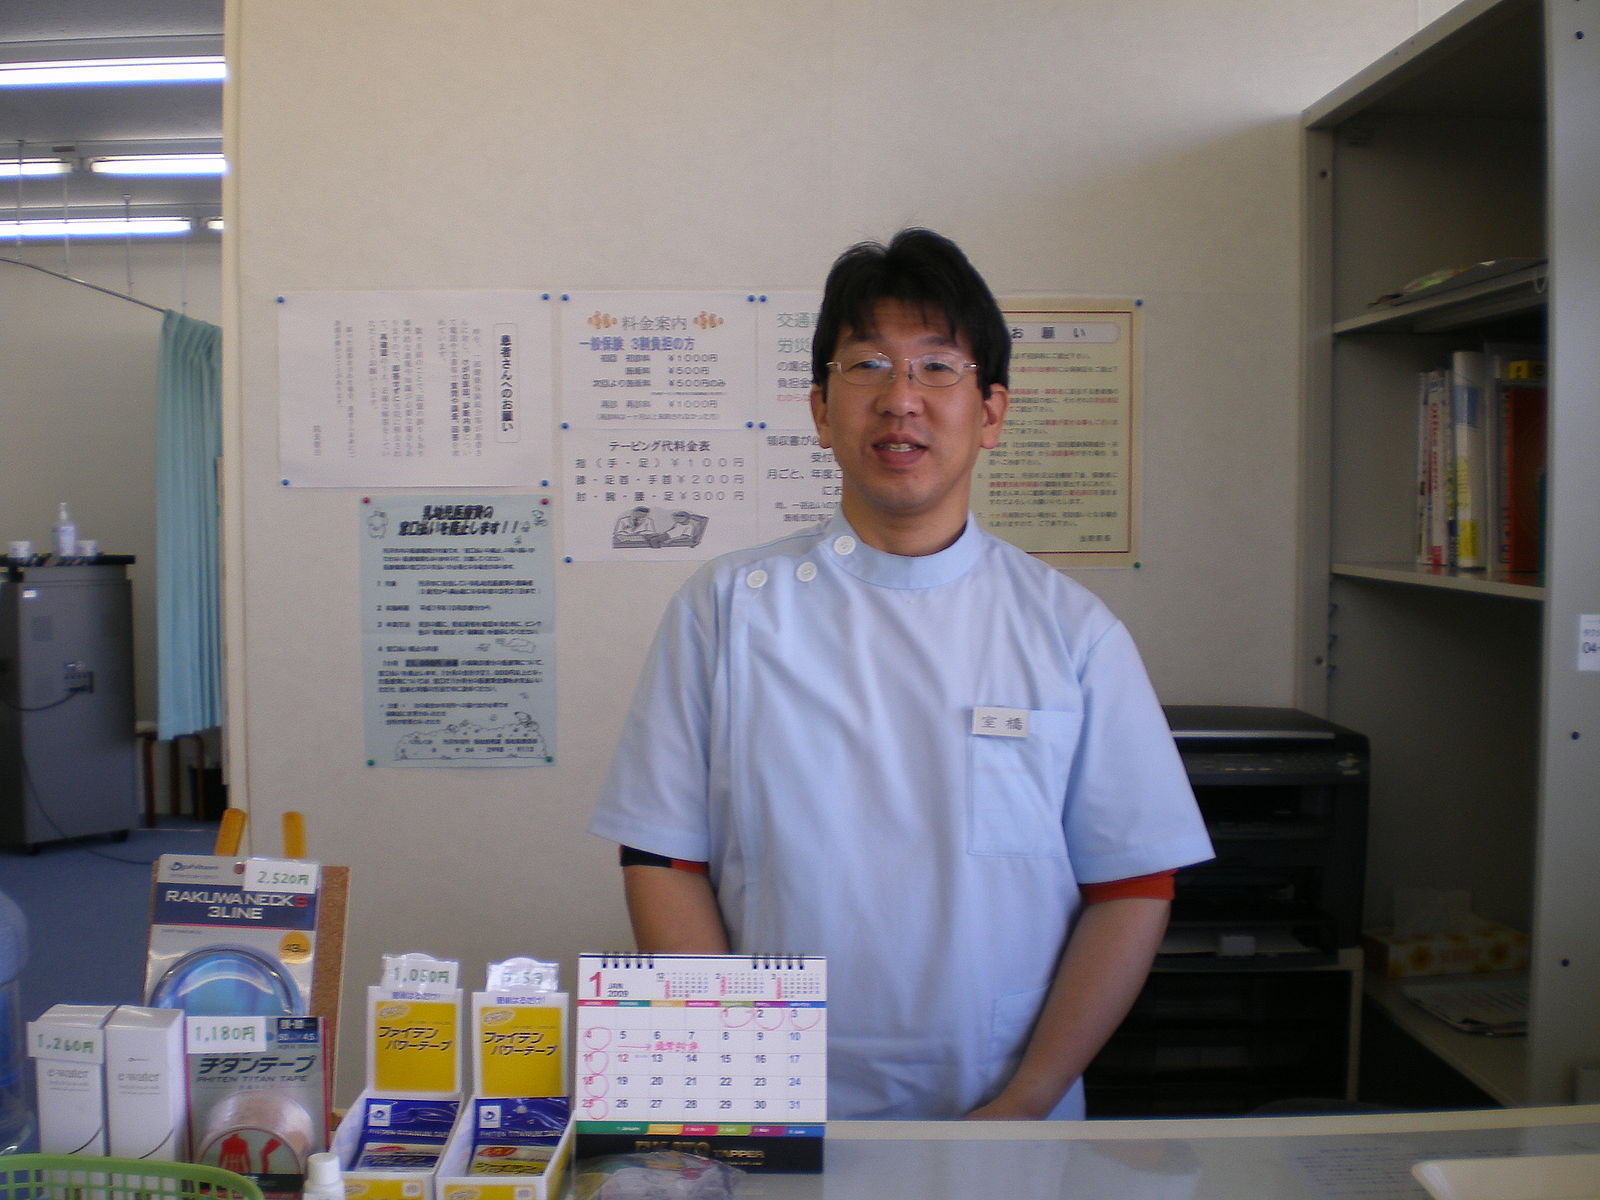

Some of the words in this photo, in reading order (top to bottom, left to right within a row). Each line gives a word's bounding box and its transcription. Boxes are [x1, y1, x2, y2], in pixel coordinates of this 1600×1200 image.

[622, 315, 688, 330] 料金案内
[609, 440, 711, 451] テーピング代料金表
[165, 890, 243, 905] RAKUWA
[207, 906, 264, 920] 3LINE
[589, 972, 602, 997] 1
[757, 1009, 764, 1018] 2
[791, 1009, 798, 1018] 3
[378, 1026, 439, 1039] ファイテン
[482, 1032, 544, 1044] ファイテン
[619, 1030, 627, 1040] 5
[654, 1030, 661, 1040] 6
[688, 1031, 695, 1040] 7
[722, 1031, 729, 1040] 8
[756, 1031, 763, 1041] 9
[385, 1040, 453, 1051] パワーテープ
[491, 1045, 558, 1056] パワーテープ
[617, 1053, 629, 1063] 12
[651, 1053, 663, 1063] 13
[685, 1054, 698, 1064] 14
[720, 1054, 732, 1064] 15
[754, 1054, 766, 1064] 16
[789, 1054, 801, 1064] 17
[617, 1076, 629, 1086] 19
[650, 1076, 663, 1086] 20
[685, 1077, 697, 1086] 21
[719, 1077, 732, 1087] 22
[754, 1077, 766, 1087] 23
[789, 1077, 801, 1087] 24
[616, 1099, 628, 1109] 26
[650, 1099, 663, 1109] 27
[684, 1100, 697, 1109] 28
[719, 1100, 732, 1109] 29
[754, 1100, 766, 1110] 30
